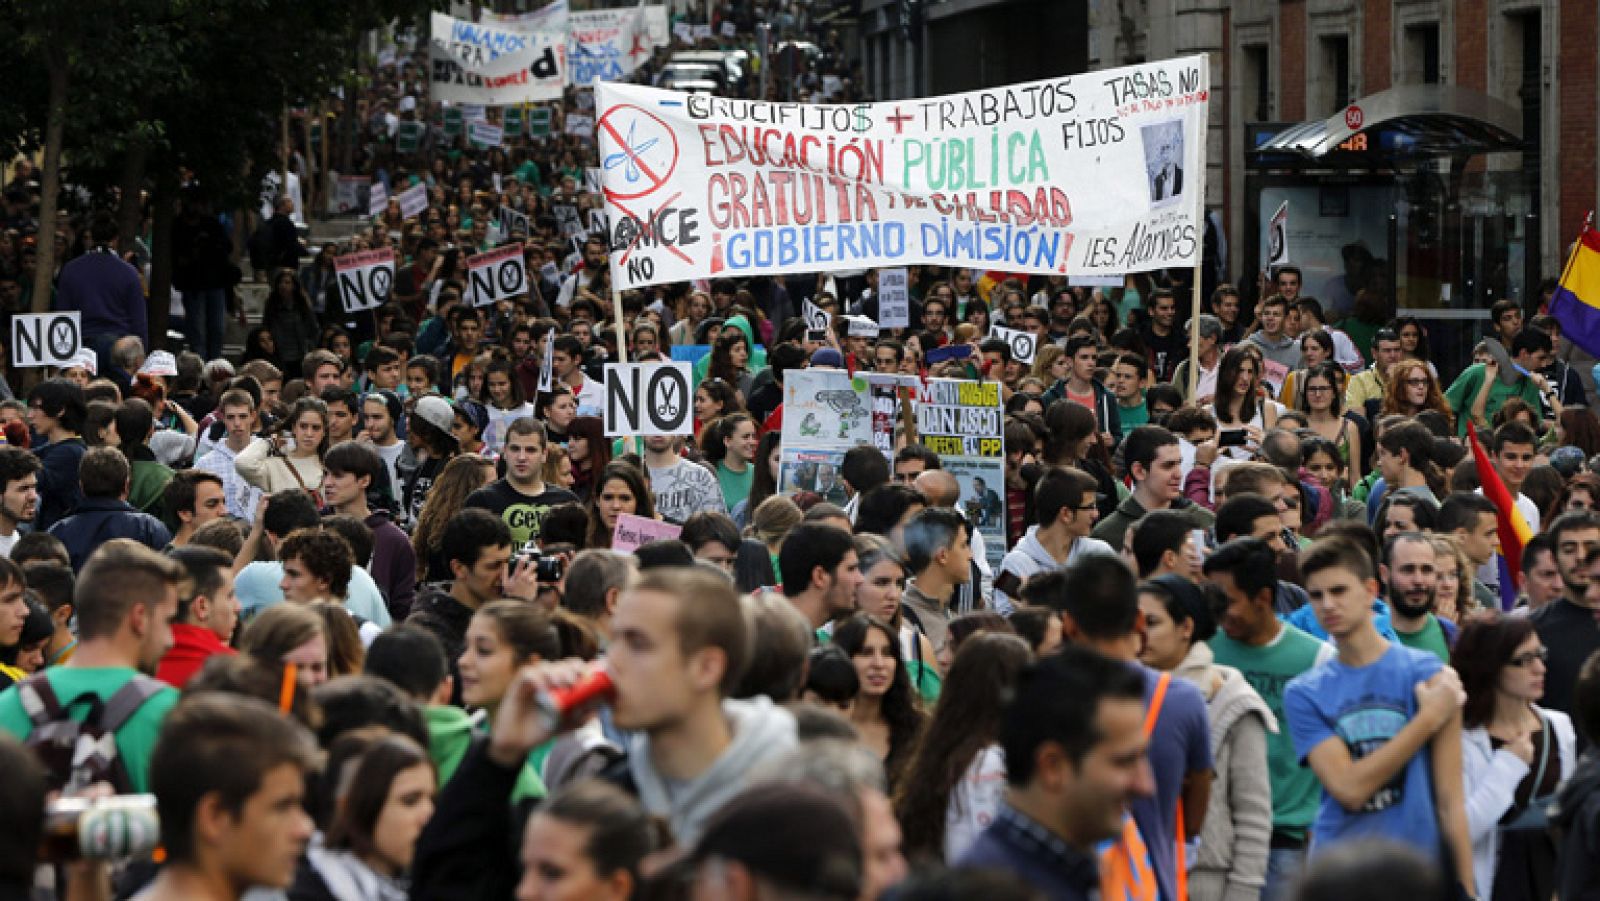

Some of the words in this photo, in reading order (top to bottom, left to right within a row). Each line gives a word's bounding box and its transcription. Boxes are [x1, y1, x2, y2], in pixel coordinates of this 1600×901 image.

[919, 79, 1076, 131] TRABAJOS
[1062, 118, 1126, 150] FIJOS
[903, 127, 1049, 191] PÚBLICA
[707, 171, 878, 229] GRATUITA
[710, 220, 906, 274] ¡GOBIERNO
[921, 216, 1074, 273] DIMISIÓN!
[340, 264, 393, 309] NO
[471, 259, 524, 304] NO
[628, 257, 655, 284] NO
[16, 316, 78, 363] NO
[607, 366, 688, 432] NO
